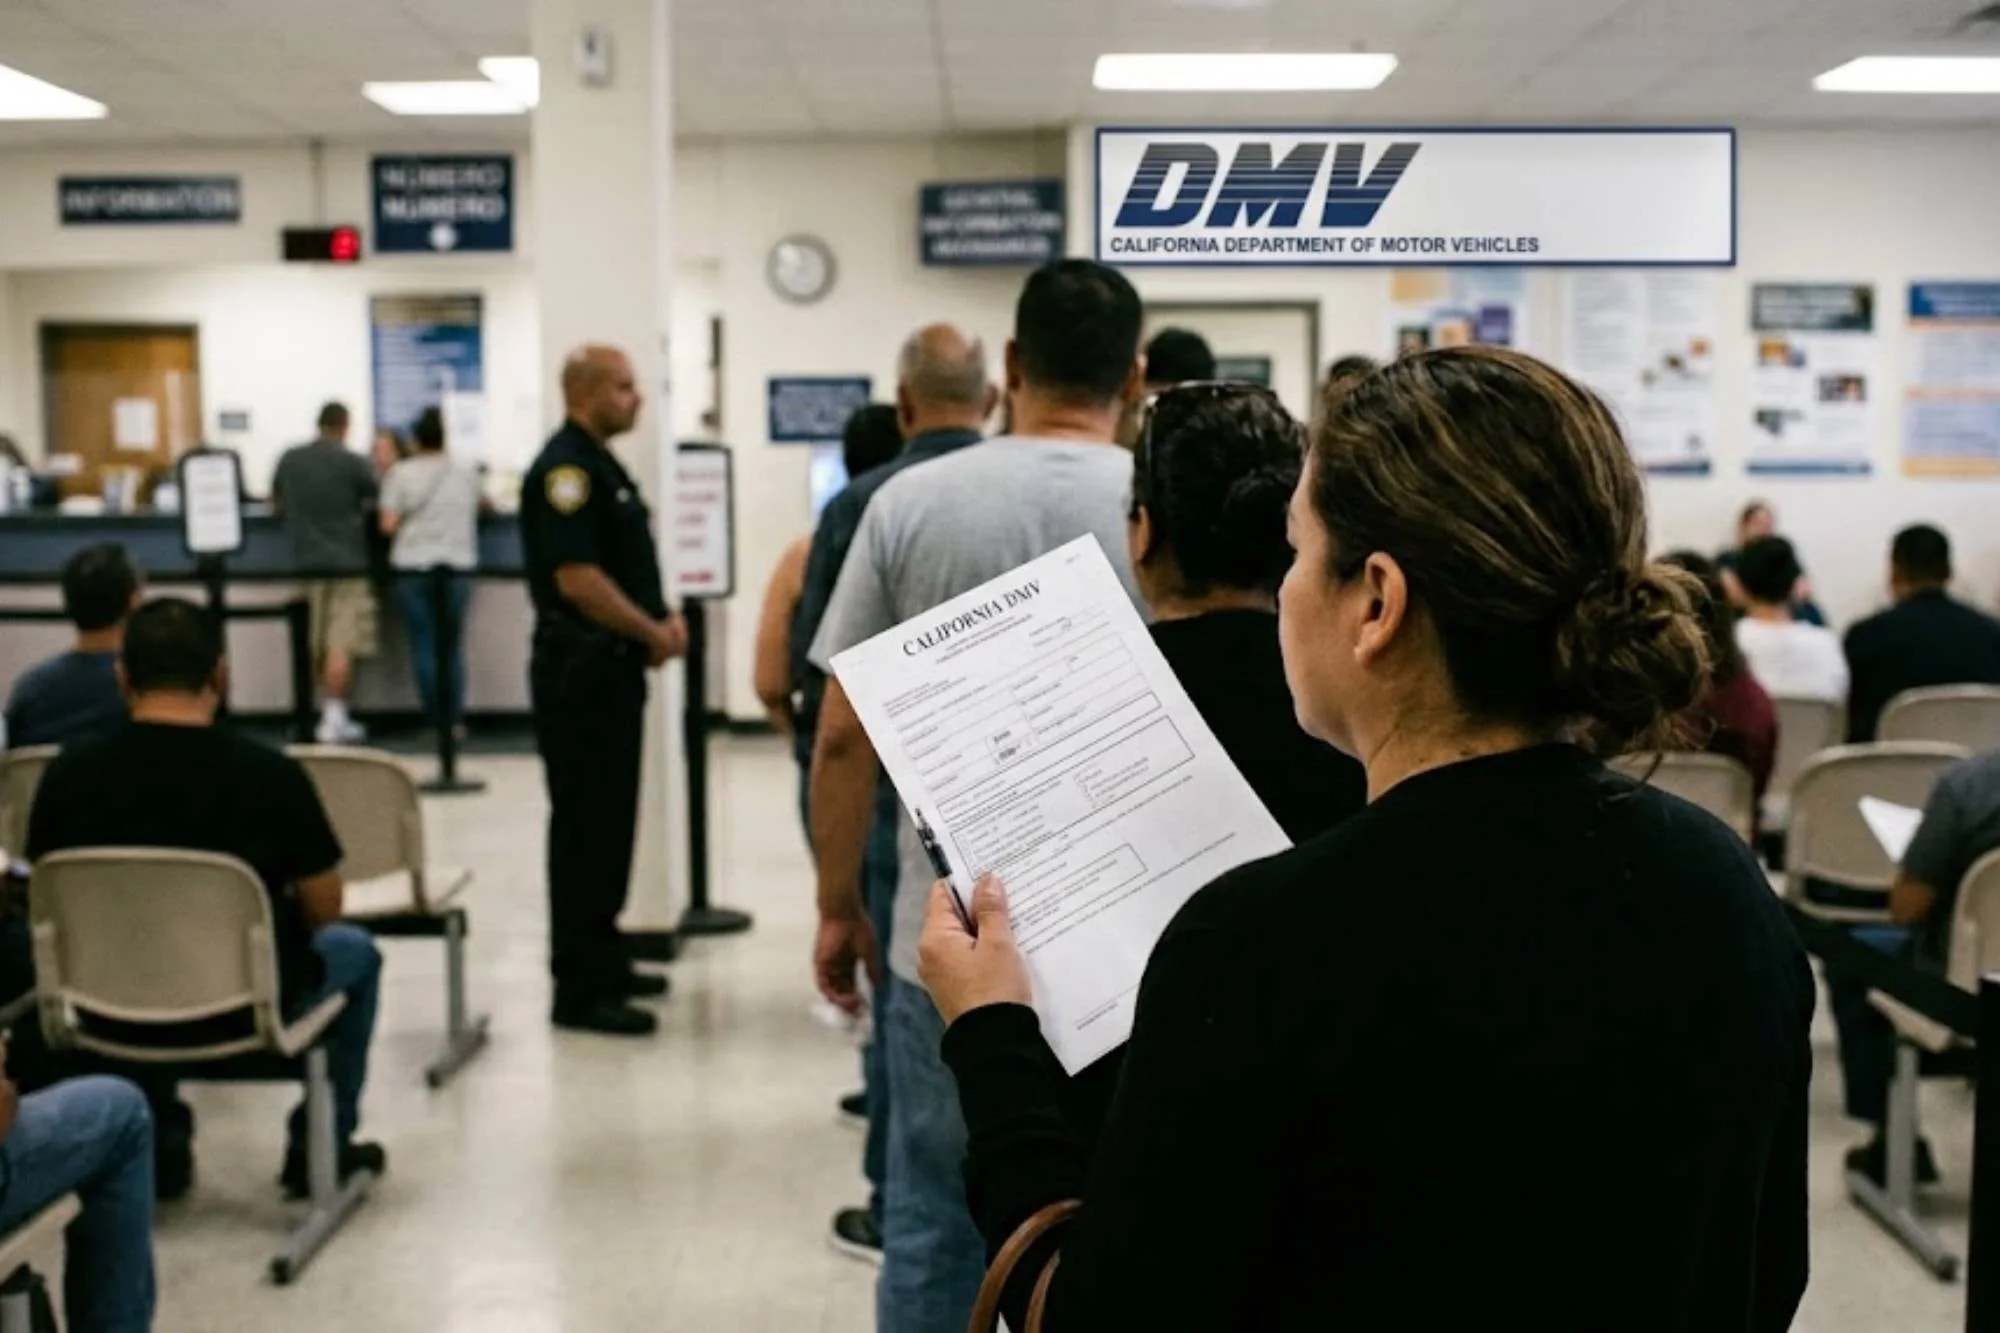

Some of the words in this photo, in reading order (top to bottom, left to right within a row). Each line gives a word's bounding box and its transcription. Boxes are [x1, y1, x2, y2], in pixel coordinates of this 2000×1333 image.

[1113, 142, 1422, 228] DMV
[1110, 237, 1219, 252] CALIFORNIA
[1225, 237, 1346, 252] DEPARTMENT
[1351, 237, 1375, 252] OF
[1382, 237, 1446, 252] MOTOR
[1450, 237, 1539, 252] VEHICLES
[903, 600, 1003, 656] CALIFORNIA
[1003, 579, 1041, 608] DMV
